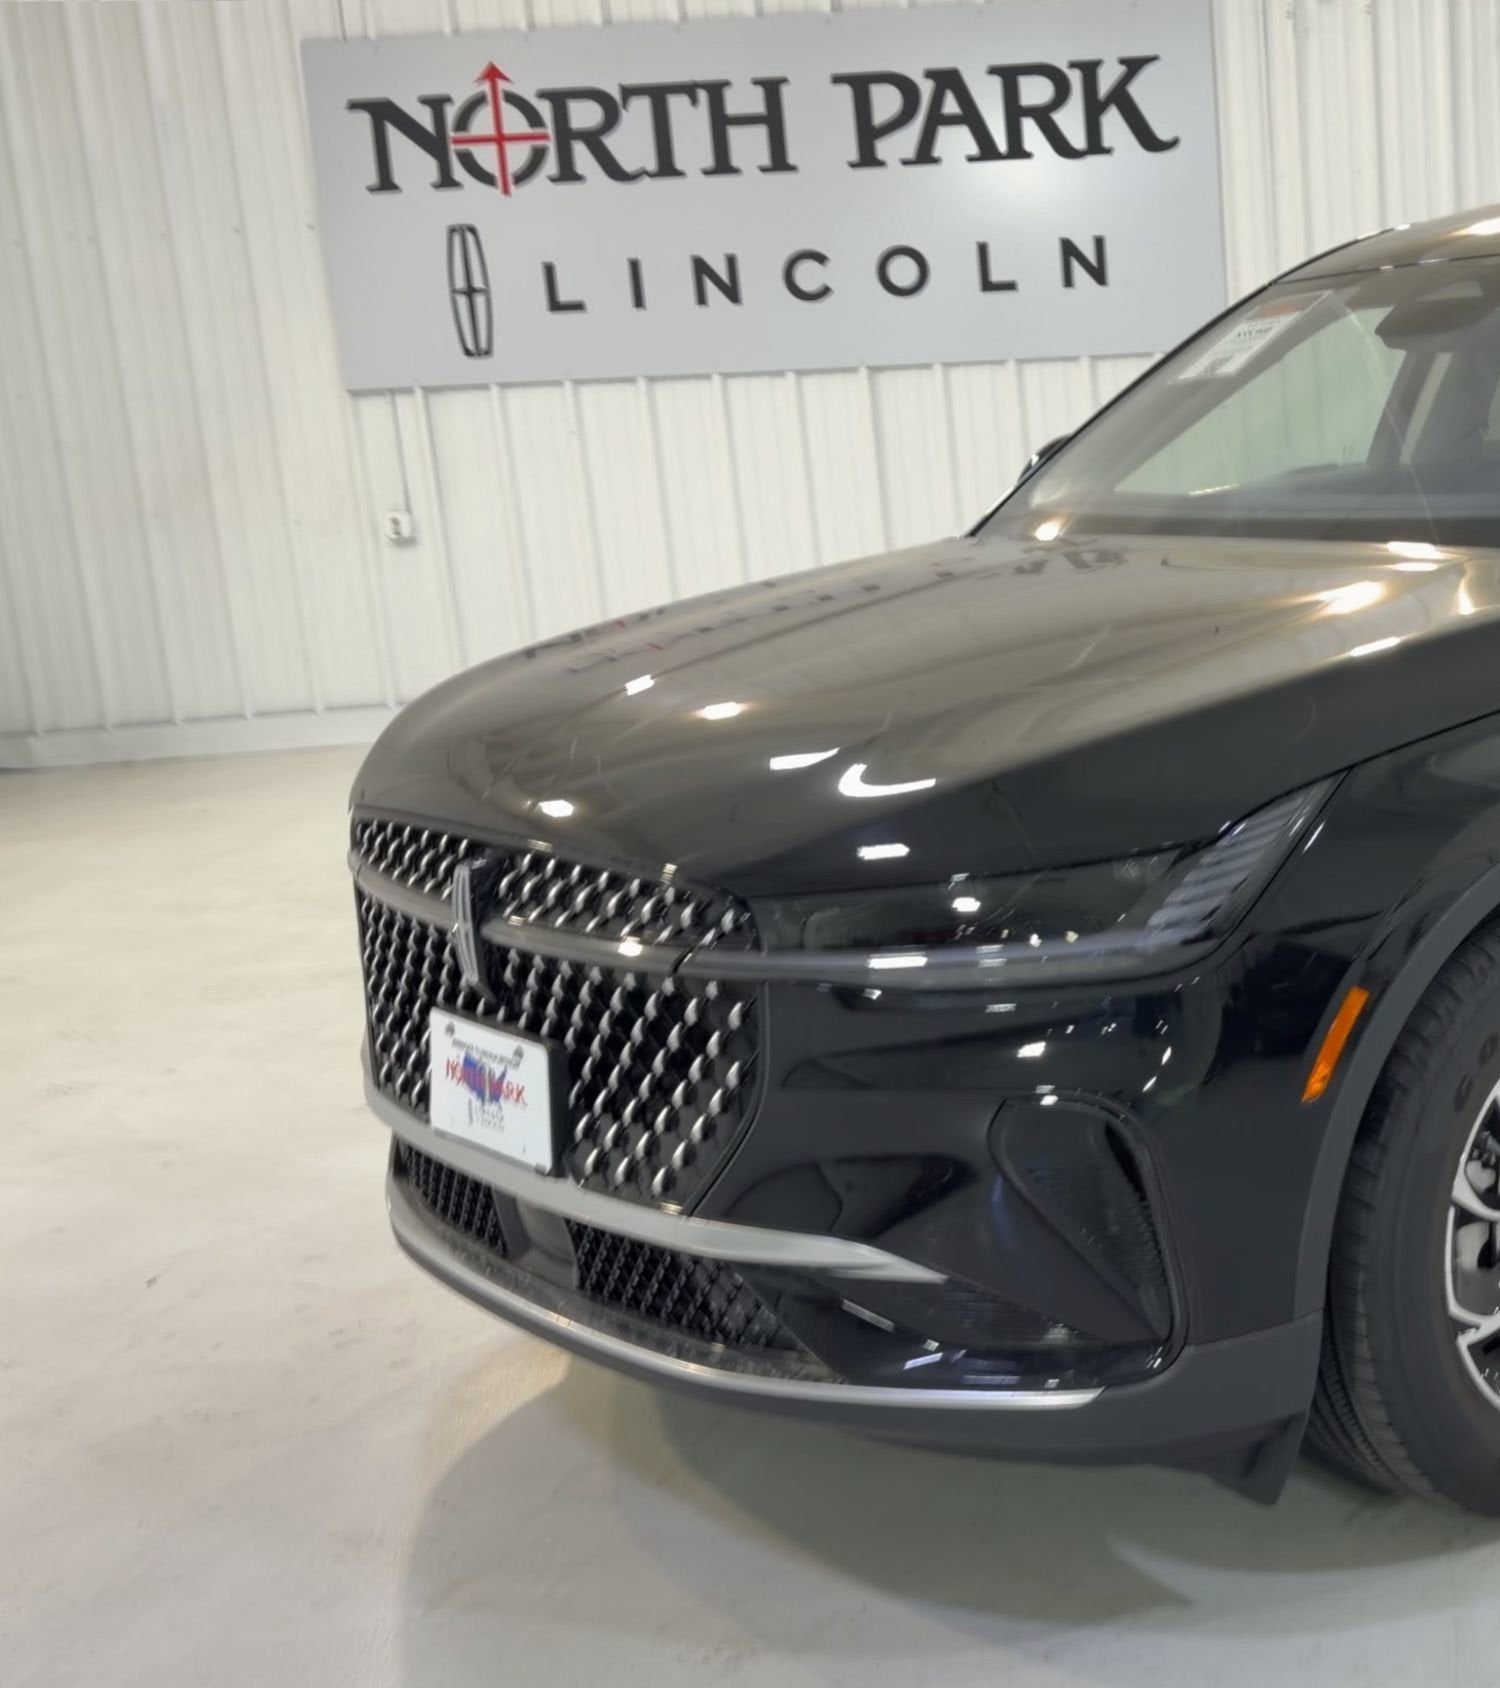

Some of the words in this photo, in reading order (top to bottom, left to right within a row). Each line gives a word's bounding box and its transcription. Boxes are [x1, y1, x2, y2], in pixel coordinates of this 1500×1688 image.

[347, 76, 798, 195] NORTH
[830, 55, 1179, 169] PARK
[541, 234, 1109, 313] LINCOLN
